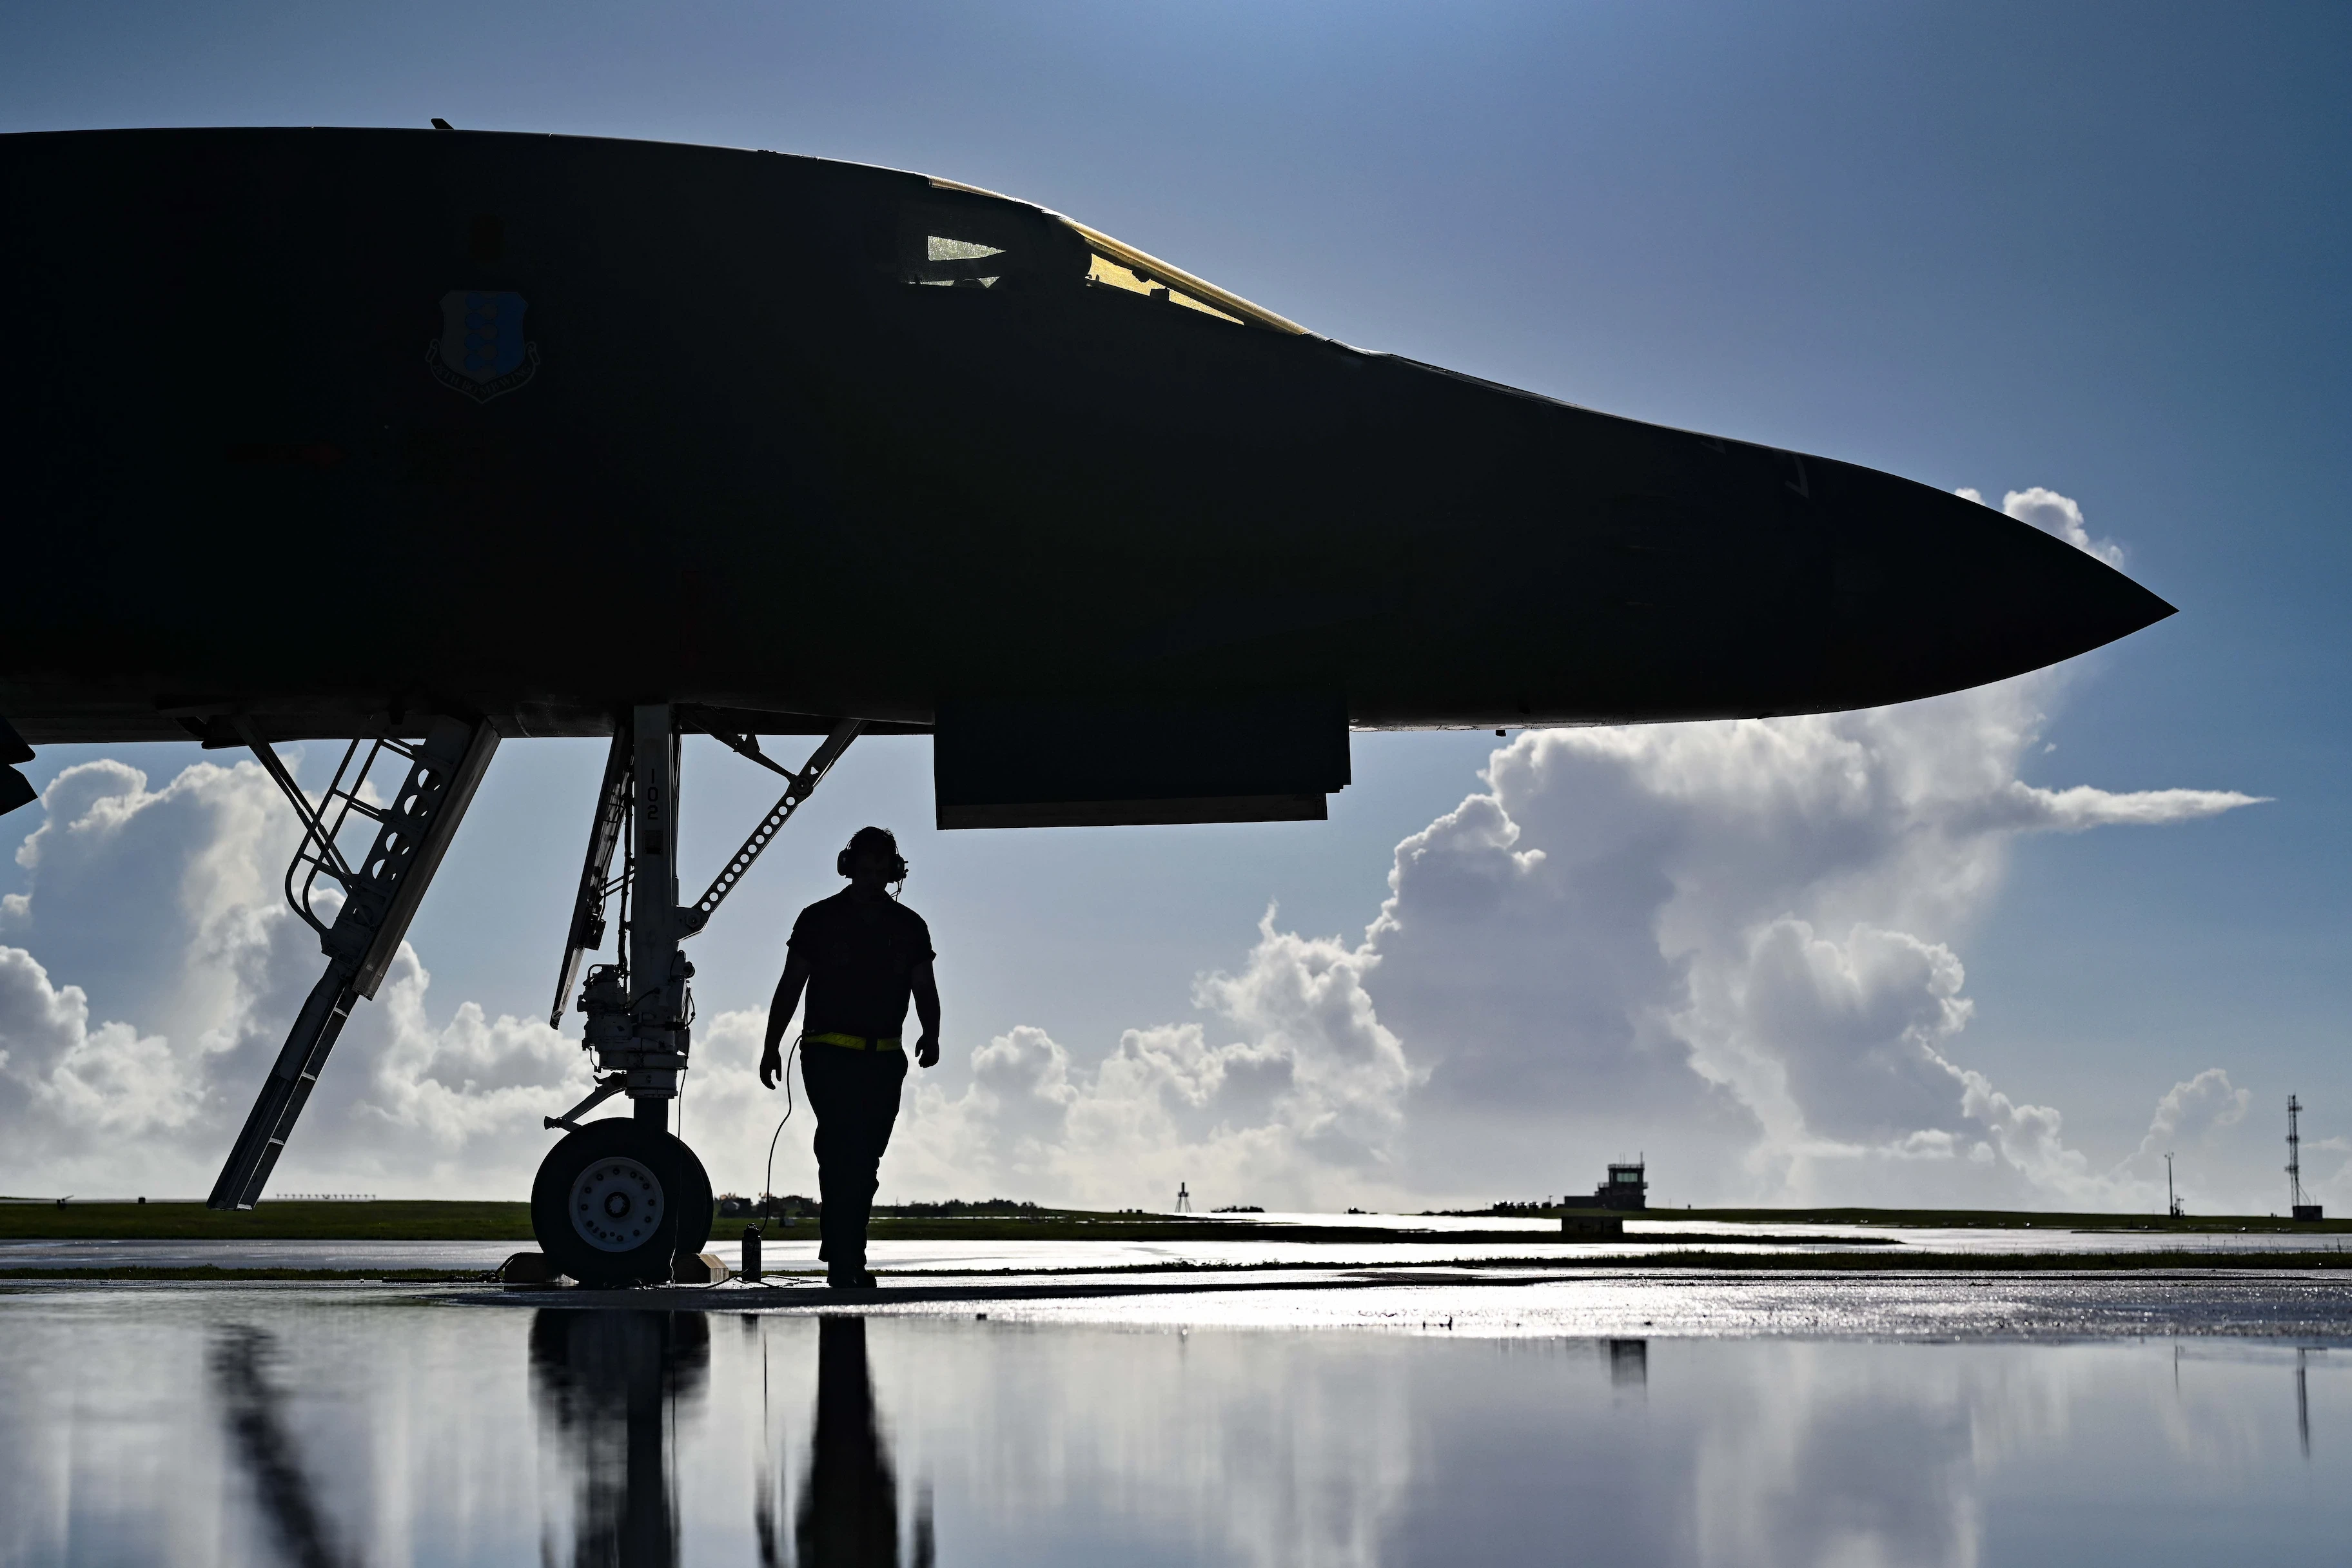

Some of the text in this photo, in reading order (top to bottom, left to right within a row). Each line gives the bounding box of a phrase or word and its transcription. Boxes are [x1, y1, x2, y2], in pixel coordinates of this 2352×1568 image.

[433, 362, 531, 396] 28TH BOMB WING
[647, 769, 658, 819] 102
